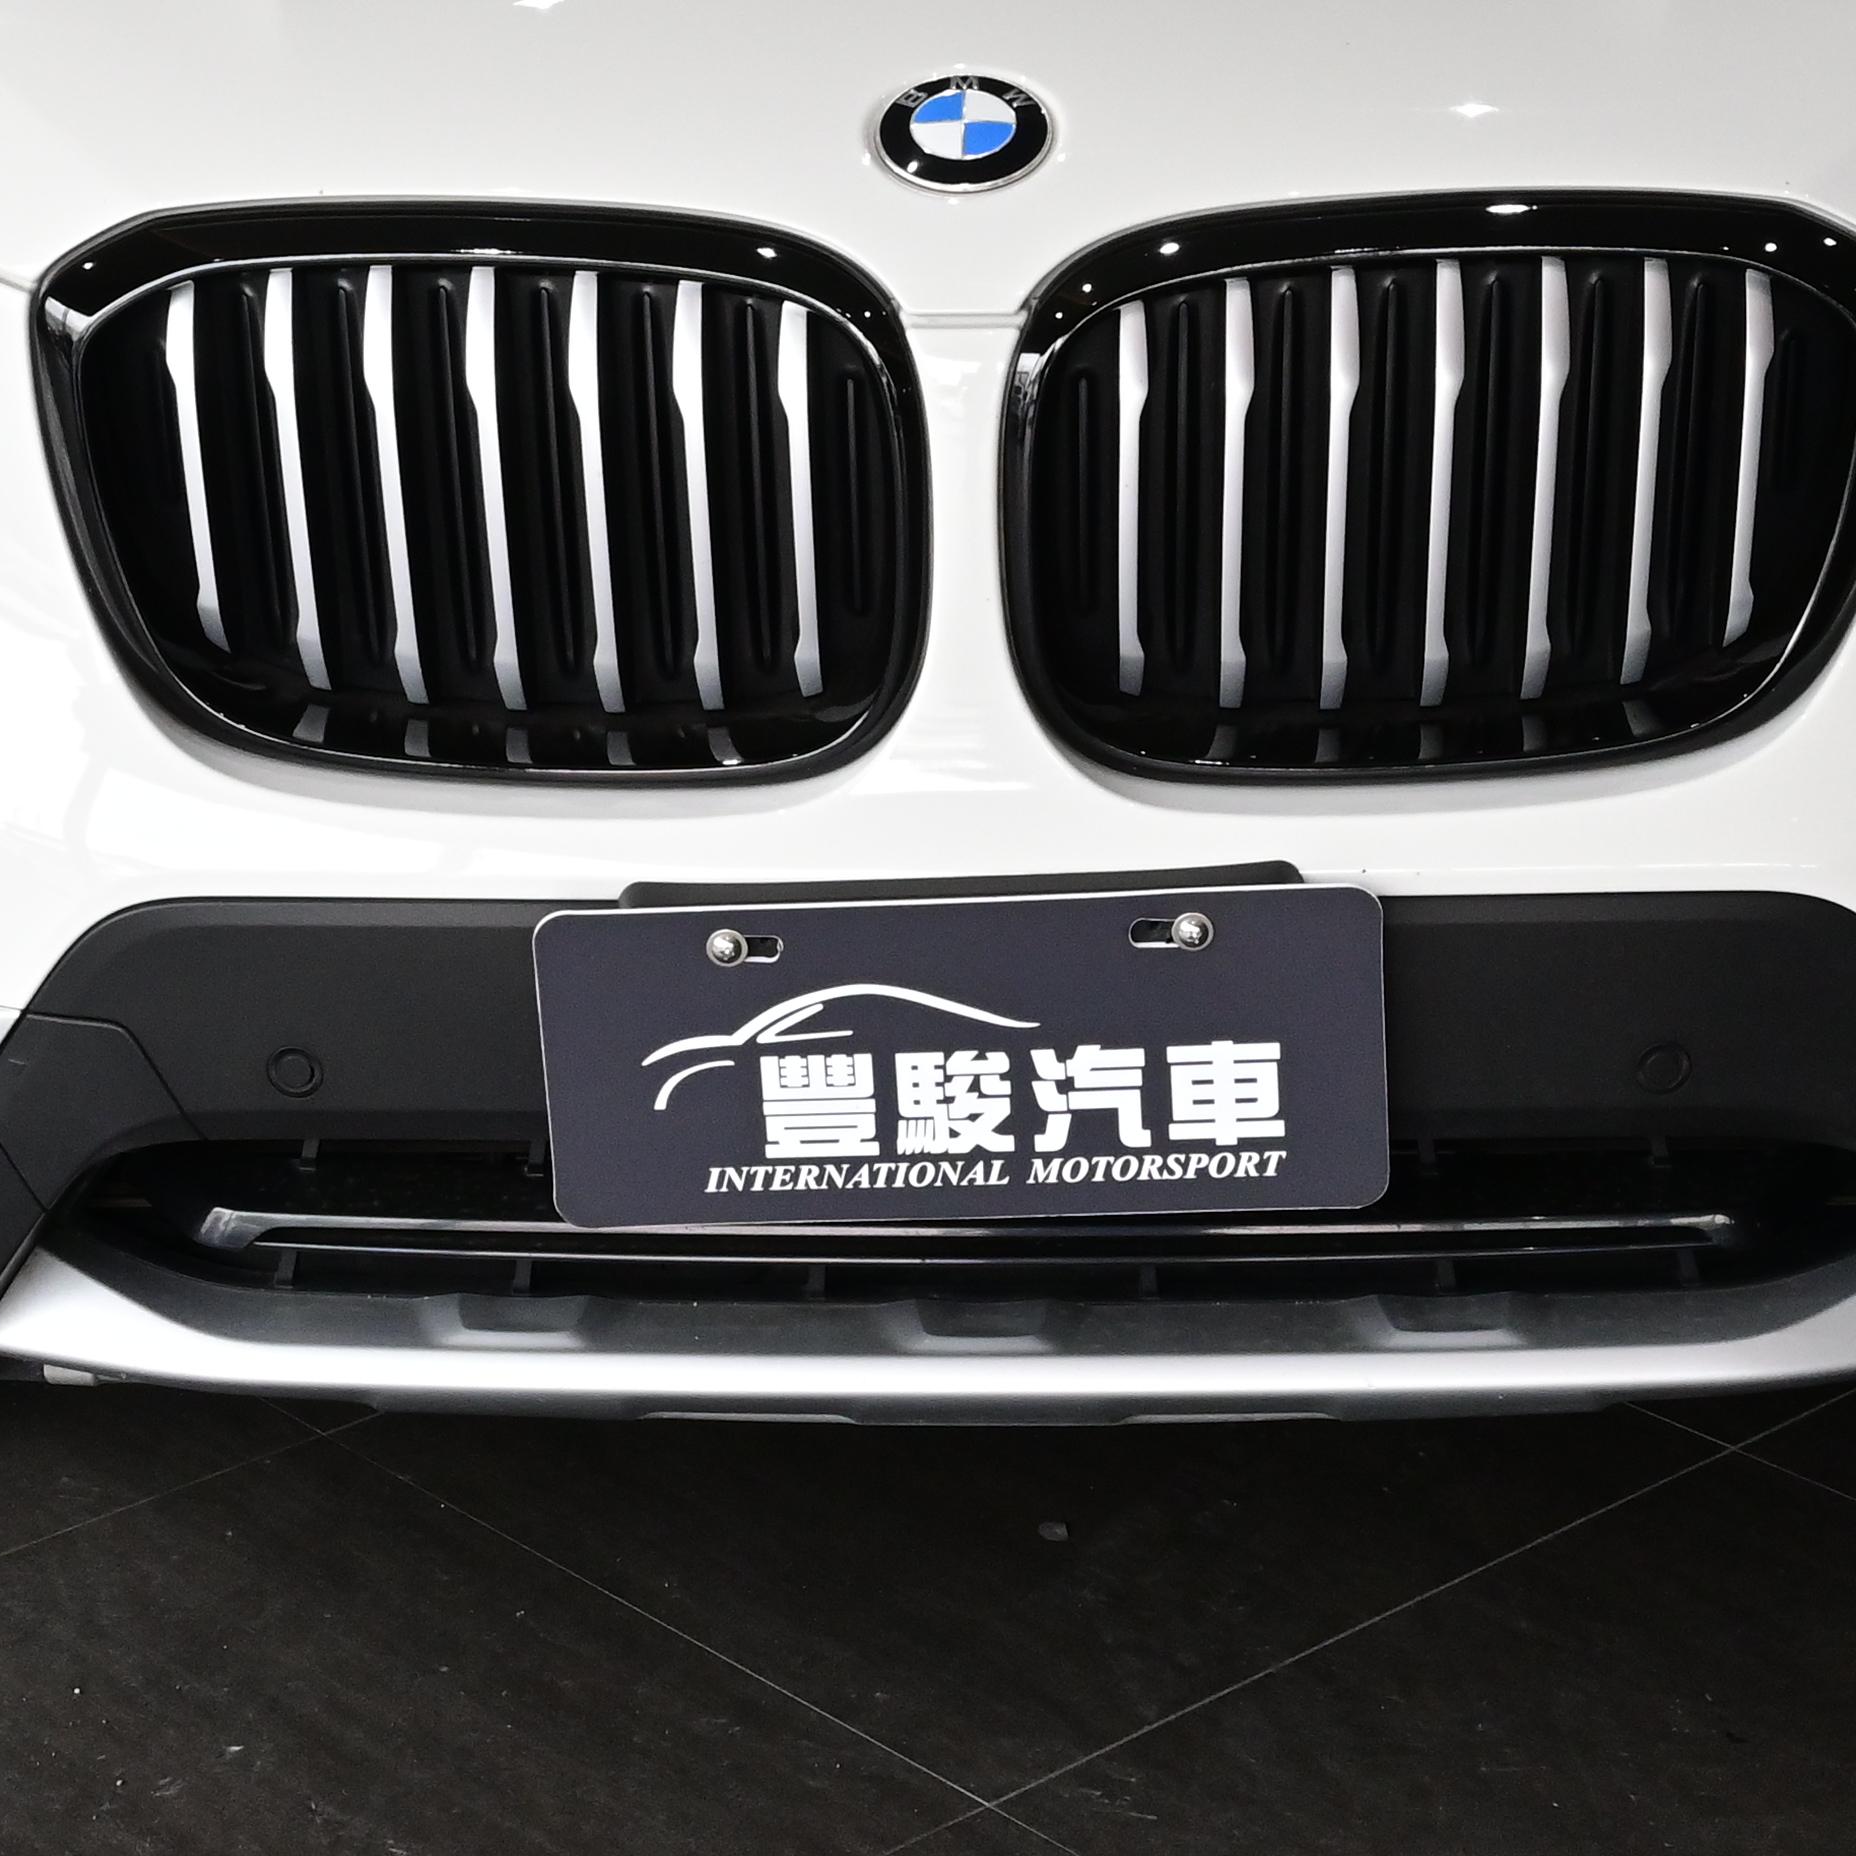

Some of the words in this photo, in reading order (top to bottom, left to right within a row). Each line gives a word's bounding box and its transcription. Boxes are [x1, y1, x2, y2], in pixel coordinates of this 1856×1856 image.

[894, 75, 1036, 109] BMW
[758, 1039, 1287, 1160] 豐駿汽車
[704, 1159, 1011, 1193] INTERNATIONAL
[1025, 1150, 1288, 1185] MOTORSPORT
